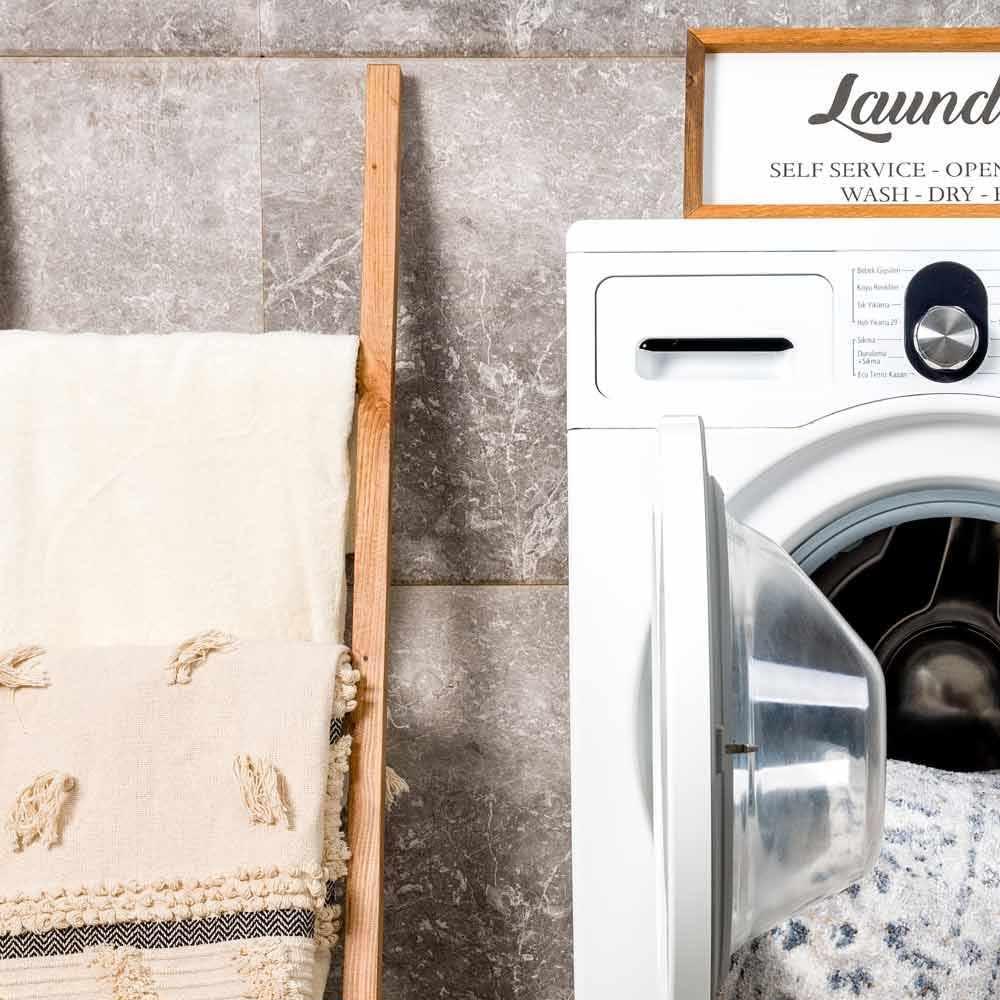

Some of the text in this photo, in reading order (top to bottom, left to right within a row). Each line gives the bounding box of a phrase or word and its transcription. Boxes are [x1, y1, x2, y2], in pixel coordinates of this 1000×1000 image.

[769, 161, 824, 179] SELF
[830, 161, 926, 179] SERVICE
[840, 185, 910, 203] WASH
[928, 185, 976, 203] DRY
